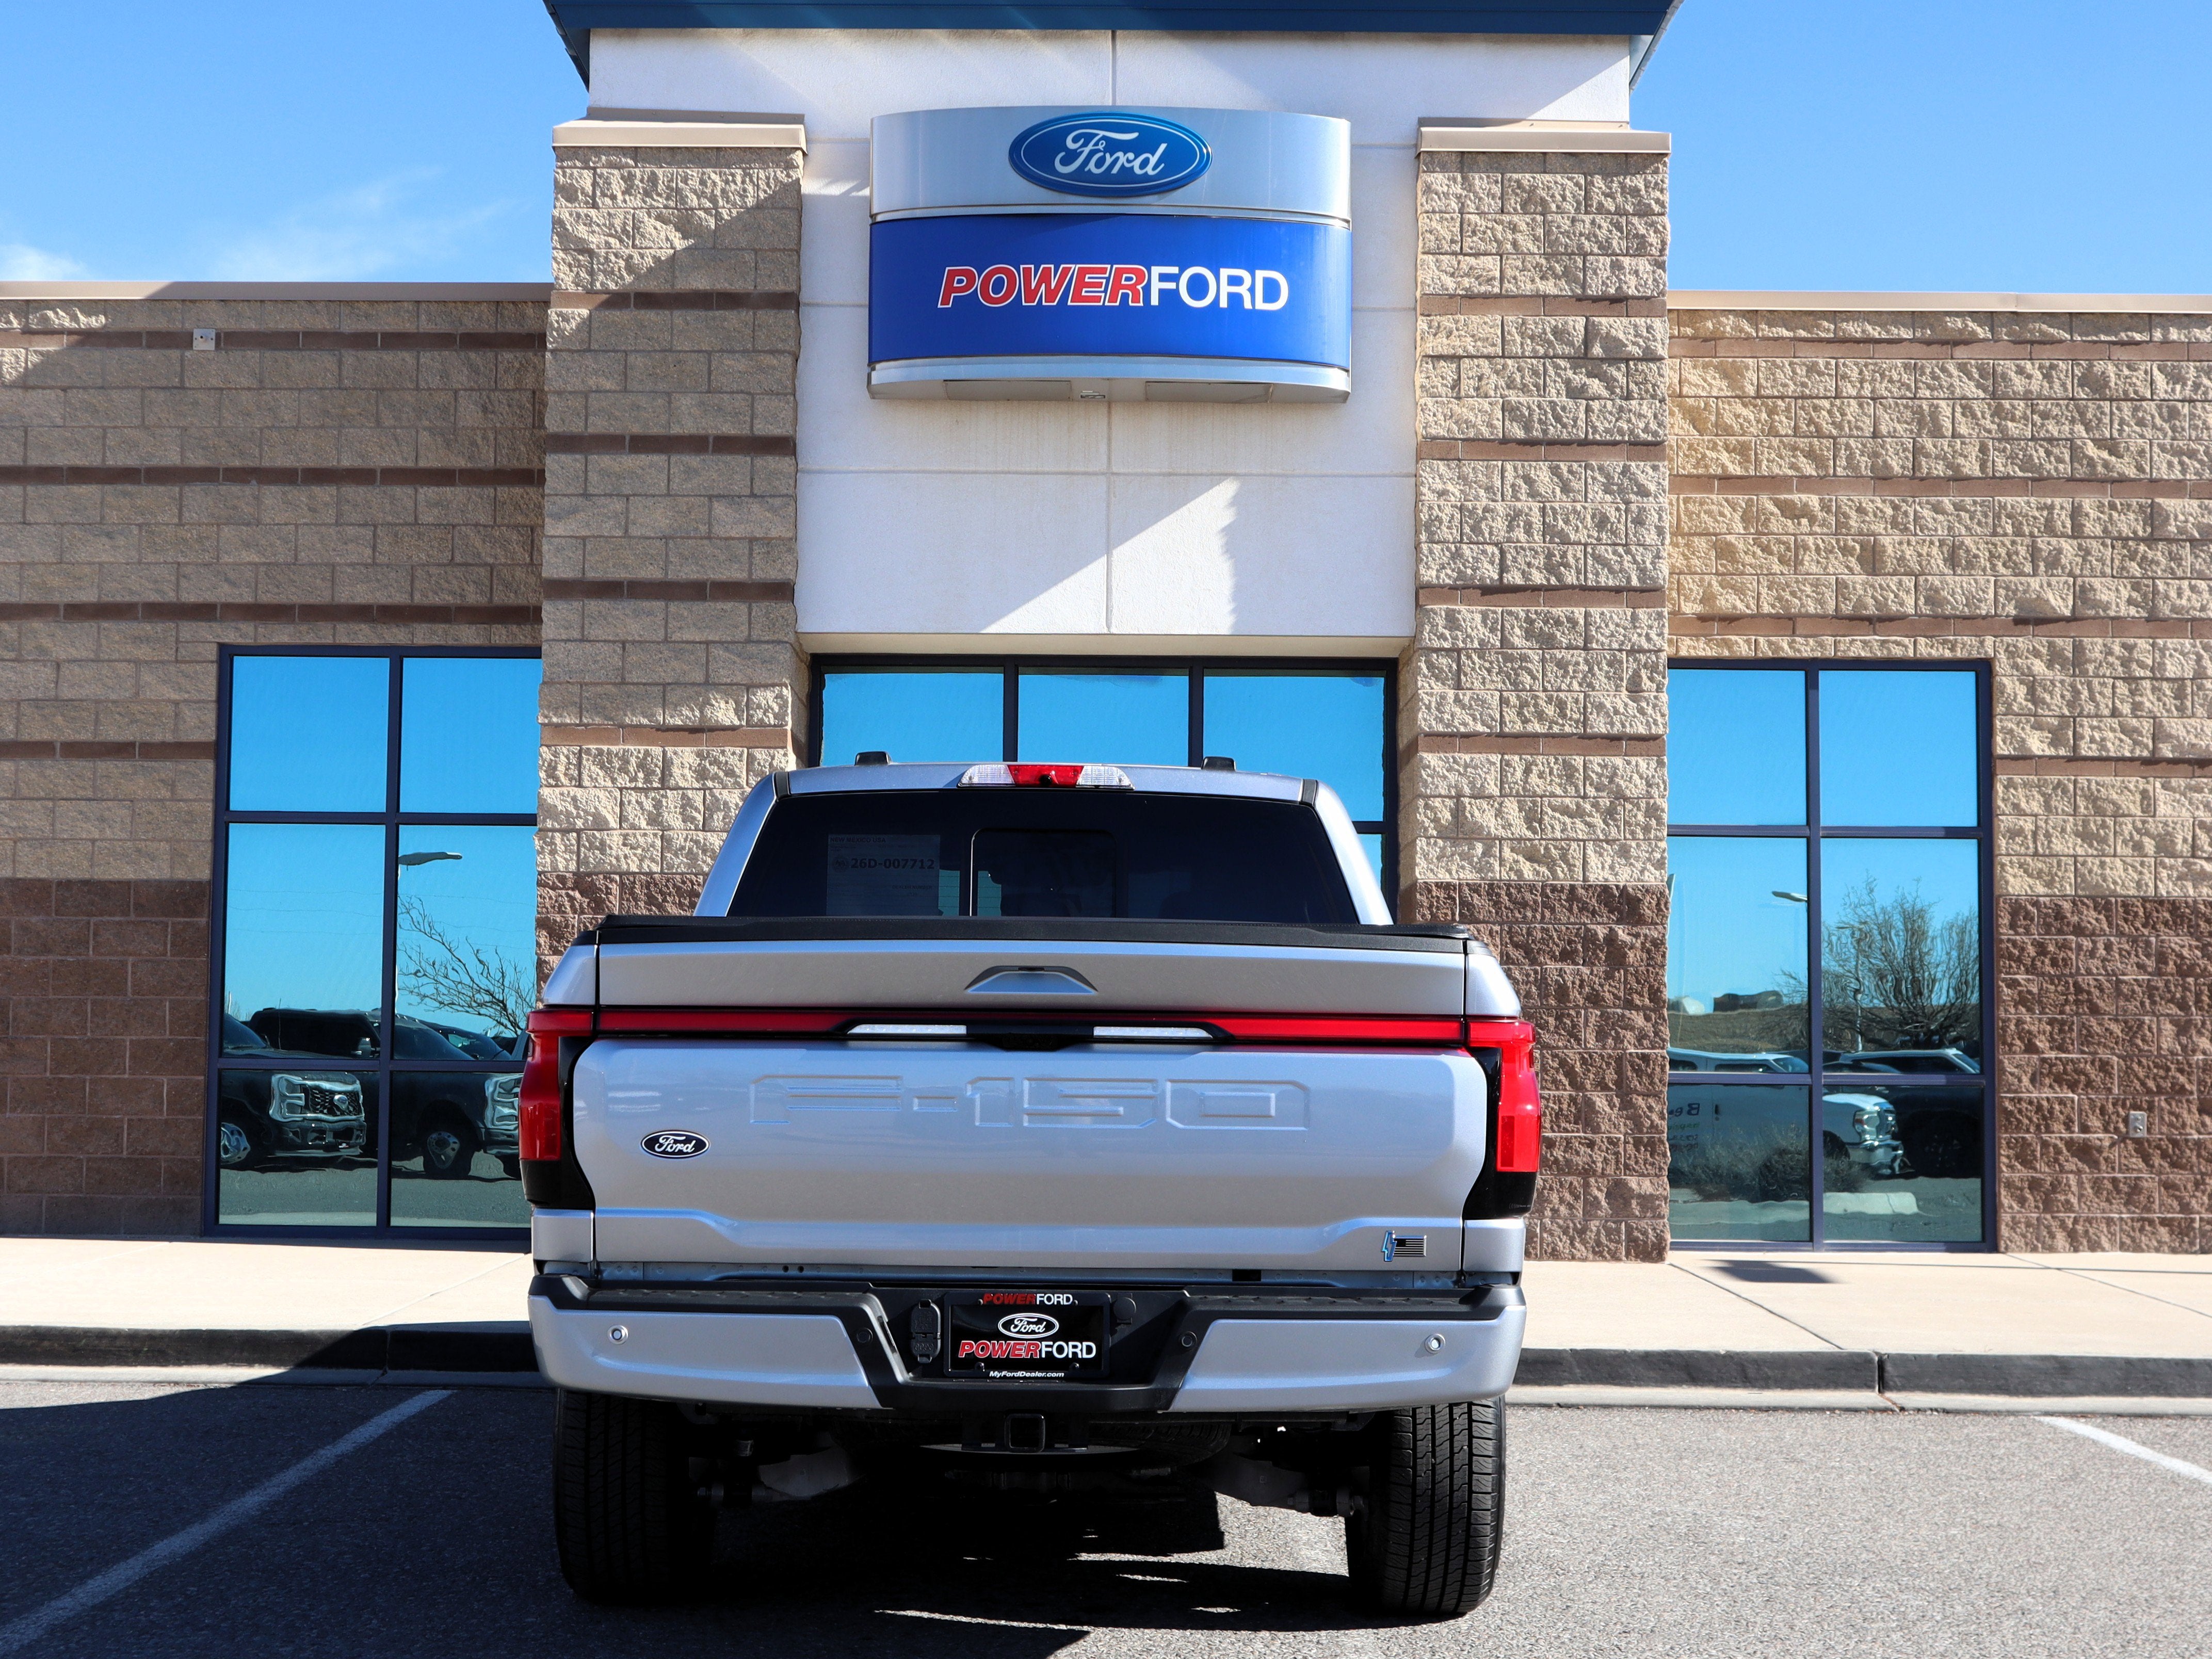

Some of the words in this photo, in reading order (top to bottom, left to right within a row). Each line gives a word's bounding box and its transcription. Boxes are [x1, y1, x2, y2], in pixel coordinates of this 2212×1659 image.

[1054, 128, 1167, 176] Ford
[938, 264, 1289, 310] POWERFORD
[851, 858, 934, 869] 26D-007712
[750, 1075, 1310, 1131] F-150
[655, 1135, 696, 1152] Ford
[1010, 1318, 1046, 1333] Ford
[958, 1340, 1096, 1358] POWERFORD
